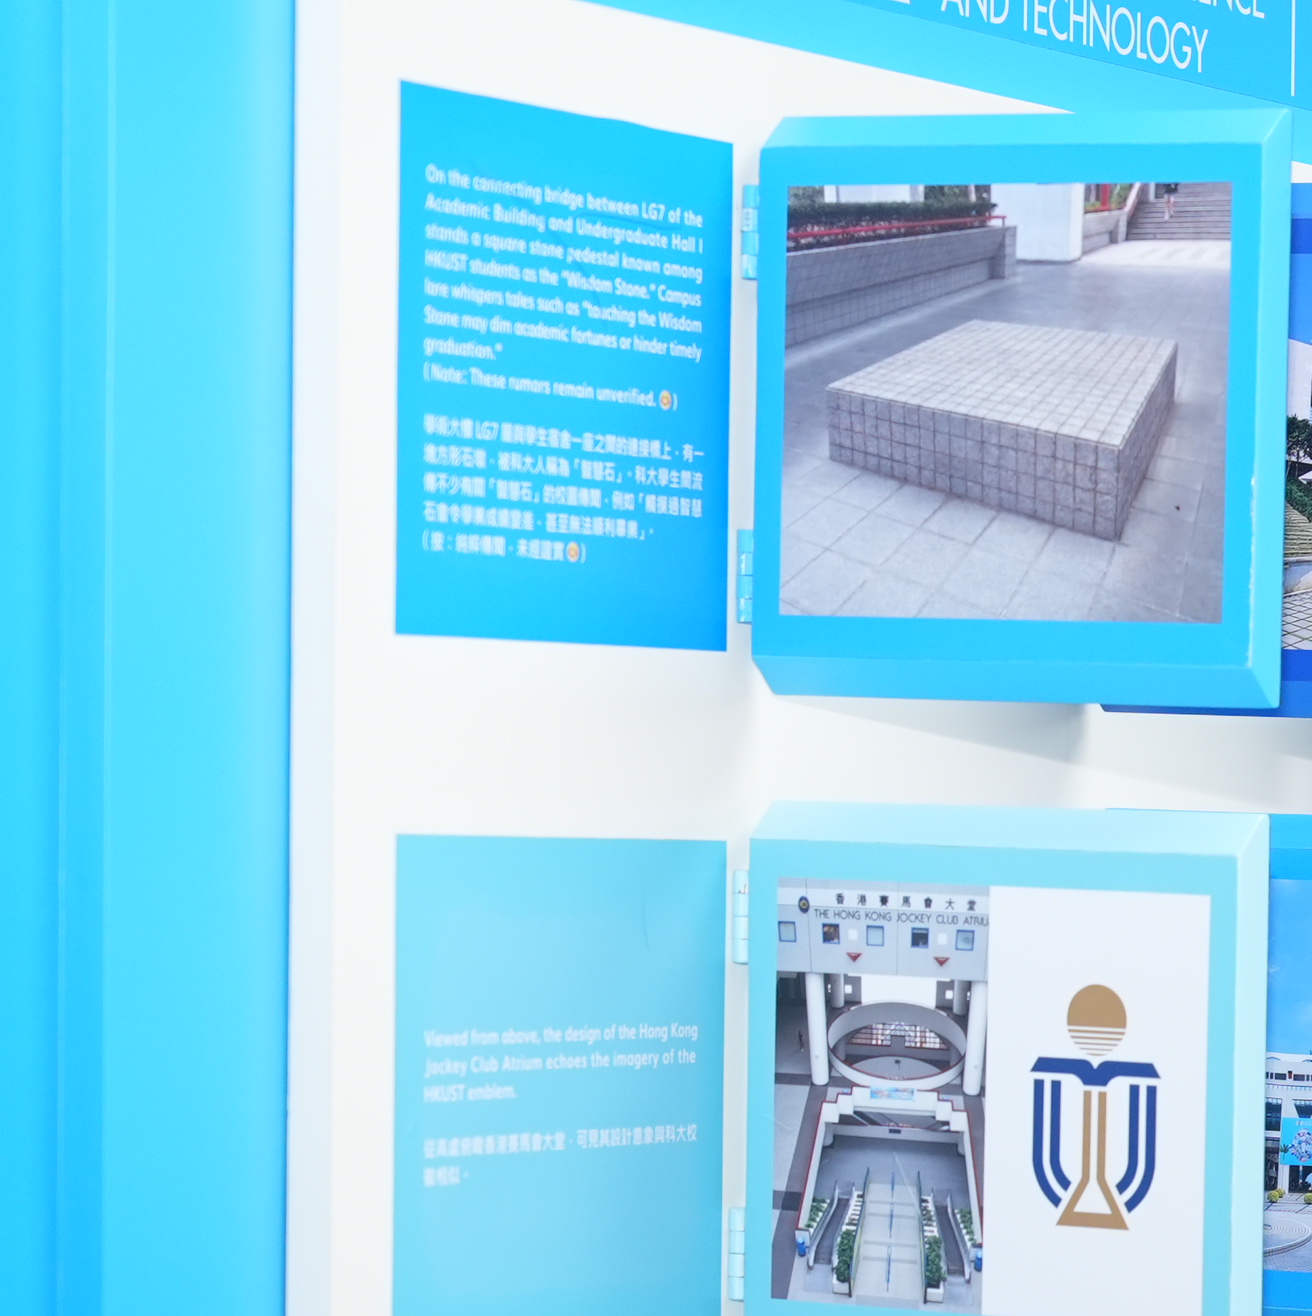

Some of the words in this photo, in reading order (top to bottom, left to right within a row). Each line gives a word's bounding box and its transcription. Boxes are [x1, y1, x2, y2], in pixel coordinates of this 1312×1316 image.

[1021, 0, 1209, 73] TECHNOLOGY
[425, 193, 490, 220] Academic
[493, 203, 546, 231] Building
[548, 217, 574, 233] and
[576, 218, 668, 248] Undergraduate
[672, 234, 696, 252] Hall
[426, 164, 446, 184] On
[448, 170, 470, 189] the
[472, 176, 543, 204] connecting
[544, 186, 584, 209] bridge
[587, 193, 639, 216] between
[642, 203, 666, 220] LG7
[668, 208, 681, 223] of
[684, 210, 703, 227] the
[425, 251, 468, 271] HKUST
[469, 259, 522, 280] students
[522, 268, 538, 282] as
[538, 268, 559, 286] the
[658, 284, 702, 307] Campus
[426, 224, 469, 244] stands
[471, 232, 481, 246] a
[483, 234, 527, 253] square
[529, 240, 564, 259] stone
[567, 247, 619, 267] pedestal
[622, 253, 661, 273] known
[663, 263, 703, 284] among
[425, 278, 451, 298] lore
[451, 283, 504, 305] whispers
[505, 291, 535, 310] tales
[536, 297, 565, 313] such
[565, 302, 580, 316] as
[638, 310, 657, 327] the
[658, 312, 702, 332] Wisdom
[424, 305, 461, 327] Stone
[461, 315, 489, 334] may
[489, 316, 514, 333] dim
[514, 322, 569, 342] academic
[570, 326, 618, 348] fortunes
[619, 337, 633, 350] or
[633, 335, 670, 354] hinder
[670, 341, 702, 362] timely
[469, 367, 507, 389] These
[508, 377, 551, 394] rumors
[553, 382, 594, 399] remain
[596, 388, 656, 406] unverified.
[814, 908, 829, 919] THE
[833, 910, 861, 921] HONG
[864, 911, 892, 922] KONG
[896, 912, 932, 924] JOCKEY
[835, 892, 977, 911] 香港賽馬會大堂
[425, 1031, 469, 1047] Viewed
[470, 1029, 500, 1045] from
[501, 1028, 541, 1044] above,
[543, 1027, 562, 1042] the
[564, 1026, 601, 1045] design
[603, 1024, 616, 1040] of
[618, 1024, 637, 1039] the
[639, 1024, 668, 1042] Hong
[671, 1022, 698, 1041] Kong
[425, 1059, 468, 1078] Jockey
[470, 1056, 499, 1073] Club
[502, 1055, 543, 1071] Atrium
[546, 1054, 588, 1070] echoes
[590, 1052, 610, 1067] the
[613, 1052, 659, 1069] imagery
[662, 1049, 675, 1064] of
[677, 1049, 696, 1063] the
[424, 1084, 465, 1102] HKUST
[467, 1084, 516, 1101] emblem.
